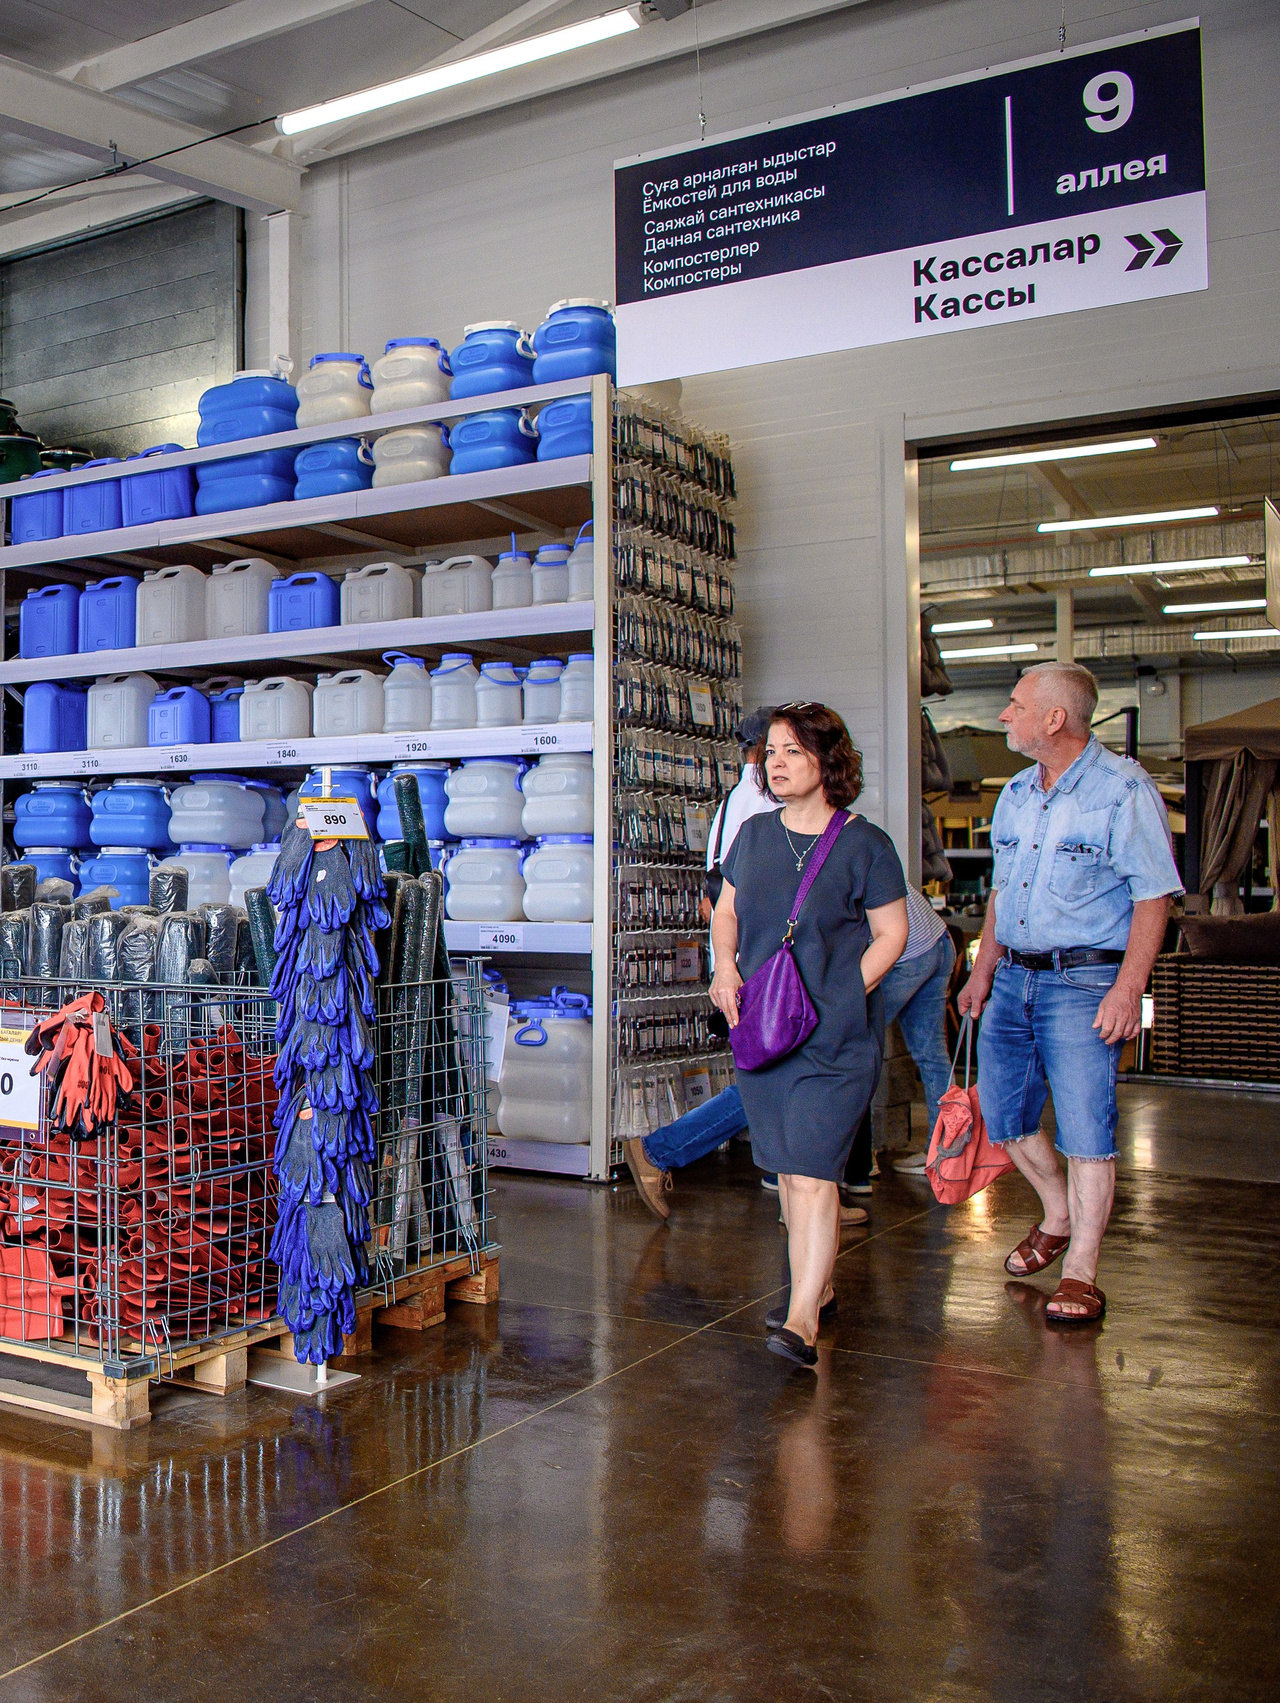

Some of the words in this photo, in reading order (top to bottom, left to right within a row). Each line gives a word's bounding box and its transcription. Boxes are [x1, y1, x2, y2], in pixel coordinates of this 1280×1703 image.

[1082, 70, 1134, 133] 9
[642, 177, 679, 197] Суға
[683, 158, 758, 189] арналған
[763, 141, 837, 168] ыдыстар
[1055, 154, 1168, 195] аллея
[643, 185, 717, 214] Ёмкостей
[721, 180, 751, 199] для
[756, 168, 798, 188] воды
[643, 210, 705, 236] Саяжай
[709, 185, 826, 222] сантехникасы
[643, 231, 702, 256] Дачная
[706, 209, 800, 239] сантехника
[643, 240, 760, 275] Компостерлер
[913, 232, 1101, 287] Кассалар
[643, 263, 742, 292] Компостеры
[913, 281, 1036, 324] Кассы
[277, 749, 296, 758] 1840
[406, 742, 427, 752] 1920
[534, 735, 557, 745] 1600
[21, 763, 38, 771] 3110
[82, 760, 99, 768] 3110
[169, 754, 188, 763] 1630
[323, 815, 347, 825] 890
[492, 934, 516, 944] 4090
